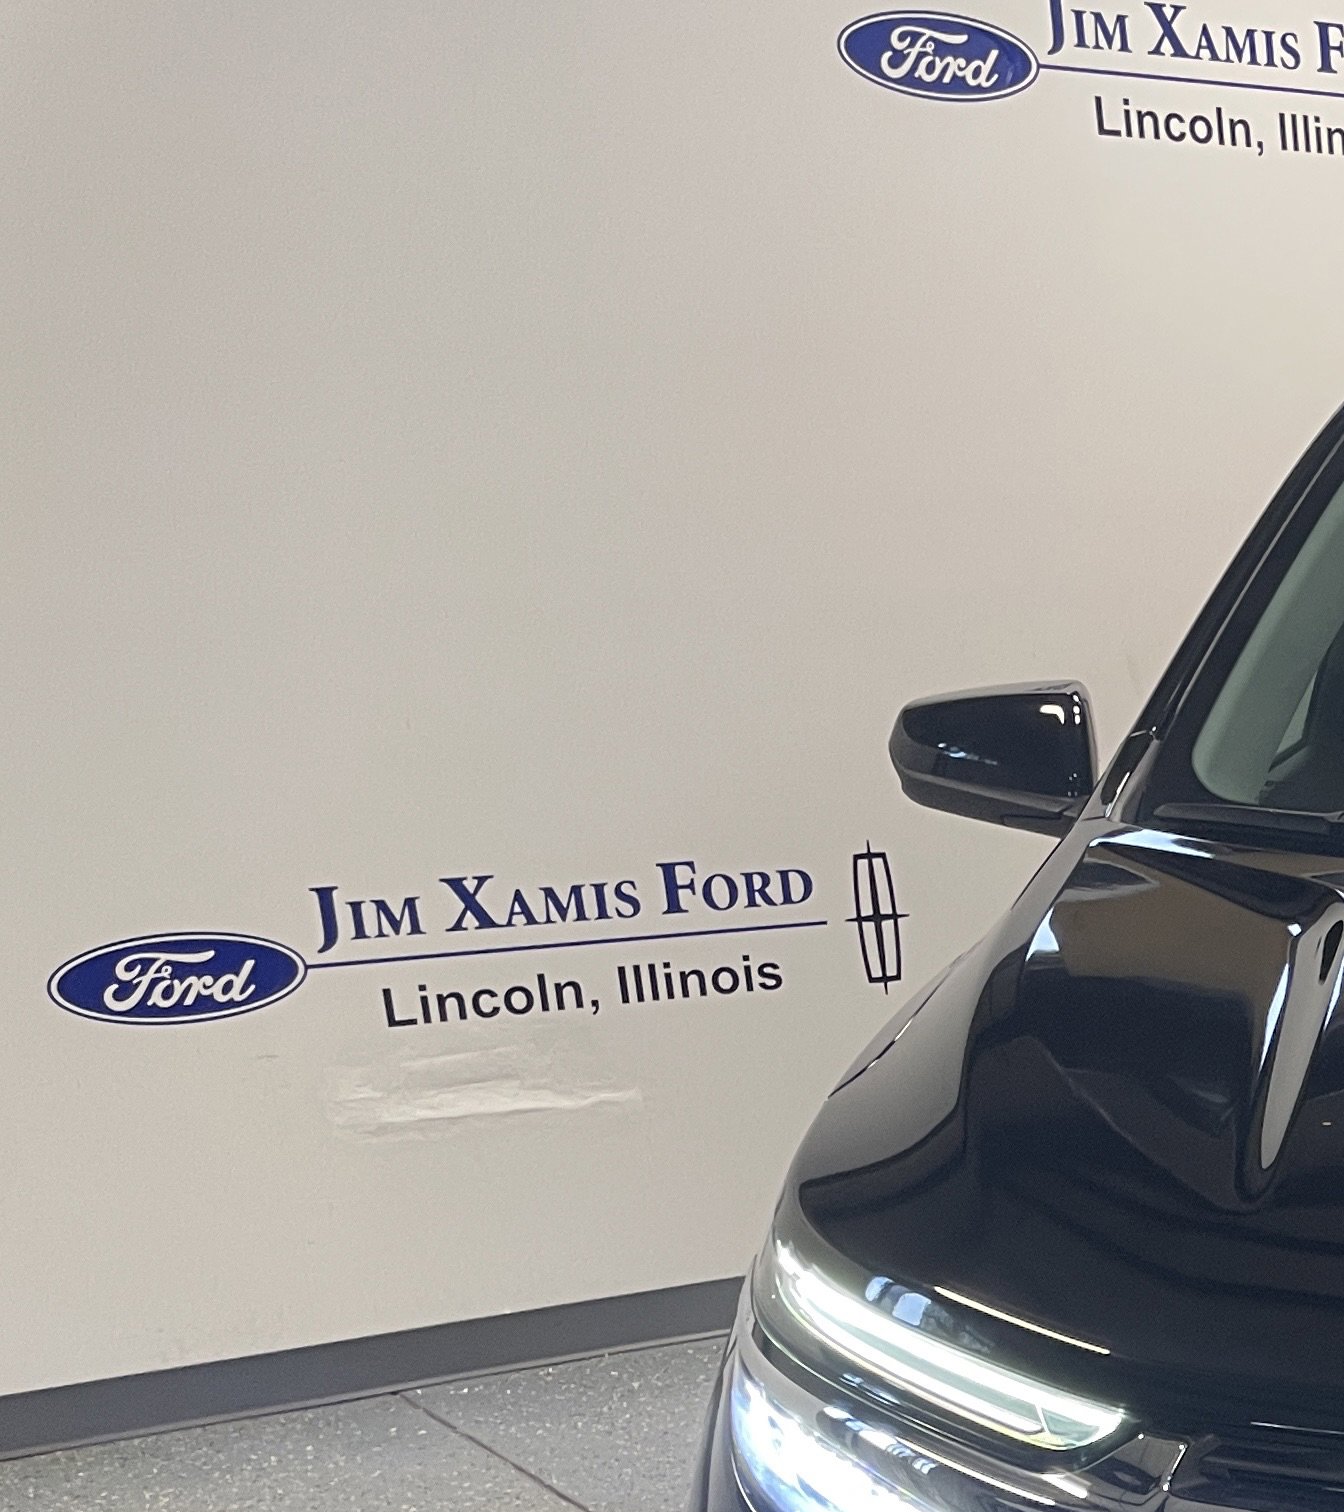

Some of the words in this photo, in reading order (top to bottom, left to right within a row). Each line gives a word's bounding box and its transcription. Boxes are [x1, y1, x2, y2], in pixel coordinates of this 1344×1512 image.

[880, 25, 999, 88] Ford
[1047, 0, 1133, 56] JIM
[1143, 1, 1301, 70] XAMIS
[1094, 95, 1264, 157] Lincoln,
[308, 885, 428, 954] JIM
[438, 874, 641, 934] XAMIS
[655, 860, 814, 915] FORD
[103, 949, 256, 1012] Ford
[381, 973, 601, 1029] Lincoln,
[617, 954, 784, 1004] Illinois
